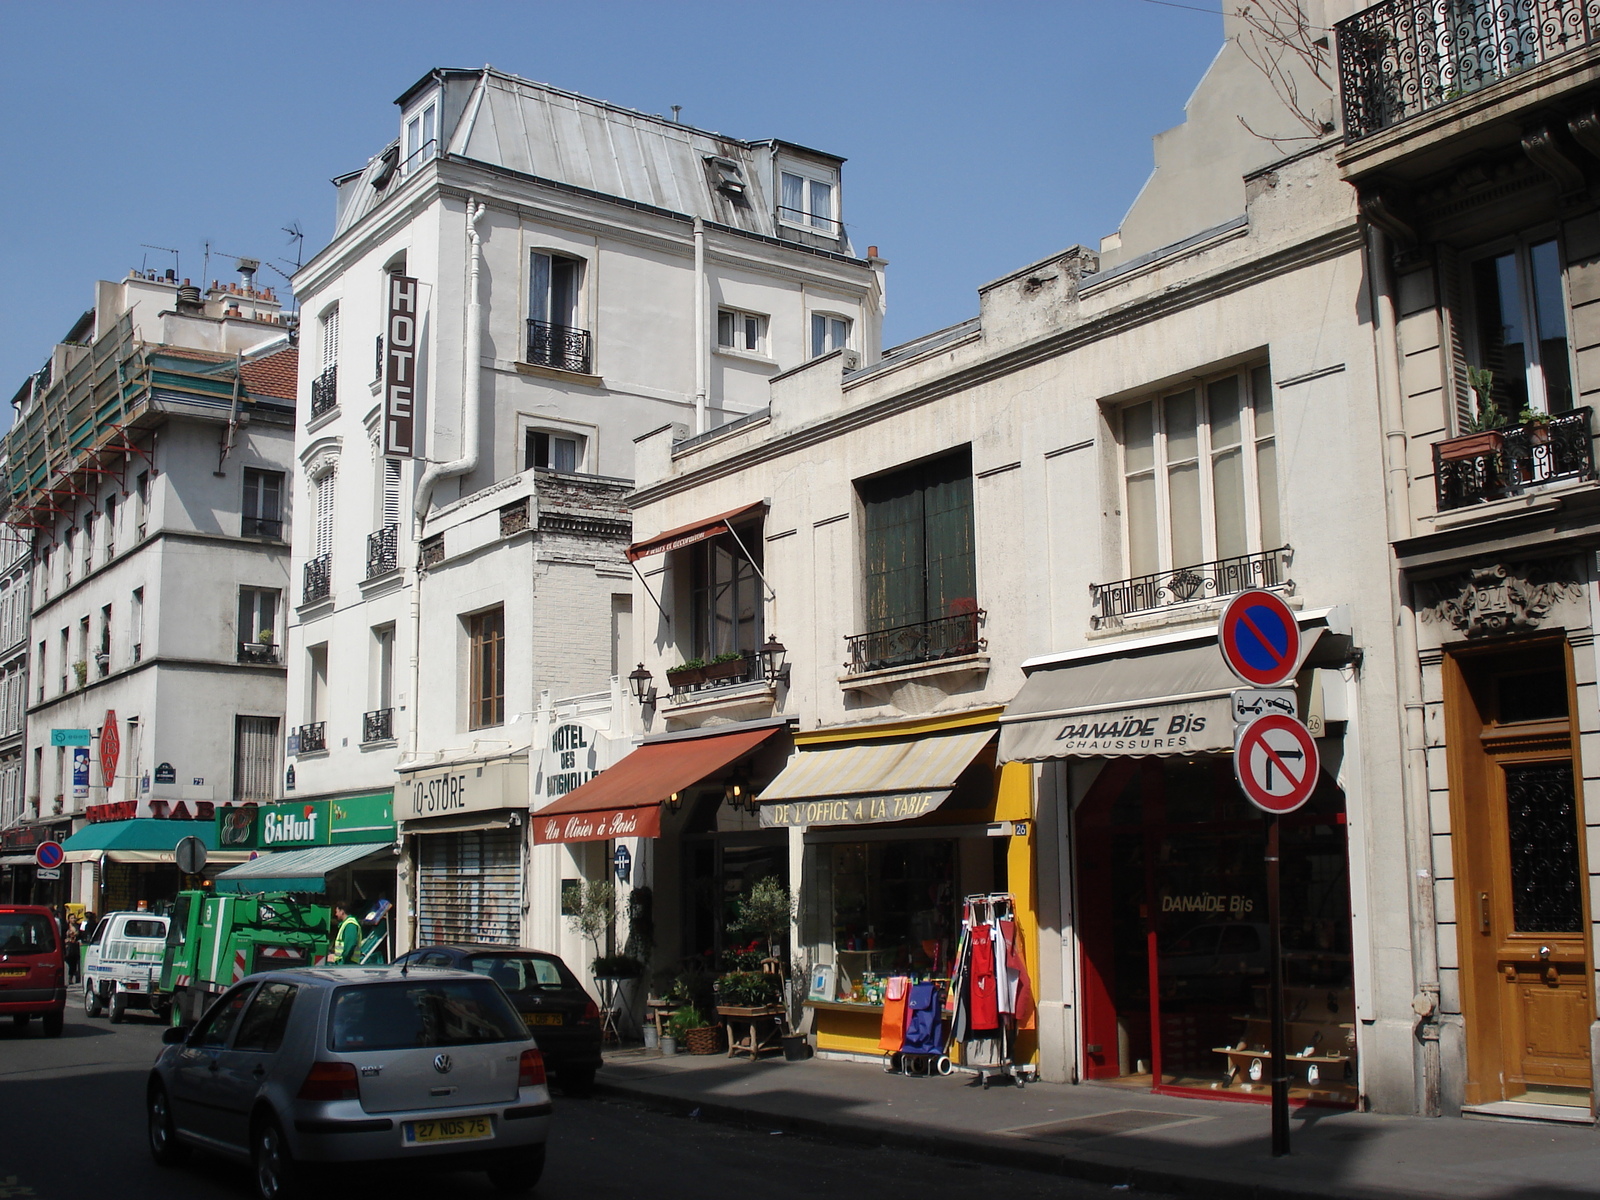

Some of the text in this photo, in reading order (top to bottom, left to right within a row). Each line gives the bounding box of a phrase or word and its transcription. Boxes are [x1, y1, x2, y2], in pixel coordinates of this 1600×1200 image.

[389, 280, 415, 453] HOTEL
[1479, 587, 1507, 611] 24
[1055, 713, 1206, 741] DANAÏDE Bis
[1308, 719, 1320, 730] 26
[103, 713, 118, 783] TABAC
[552, 724, 588, 753] HOTEL
[1066, 736, 1187, 749] CHAUSSURES
[561, 751, 575, 770] DES
[413, 775, 466, 816] iQ-STORE
[775, 796, 932, 823] DE L'OFFICE A LA TABLE
[544, 812, 637, 840] Un Olivier à Paris
[1016, 825, 1026, 835] 26
[1162, 892, 1253, 912] DANAÏDE Bis
[418, 1119, 486, 1137] 27 NDS 75
